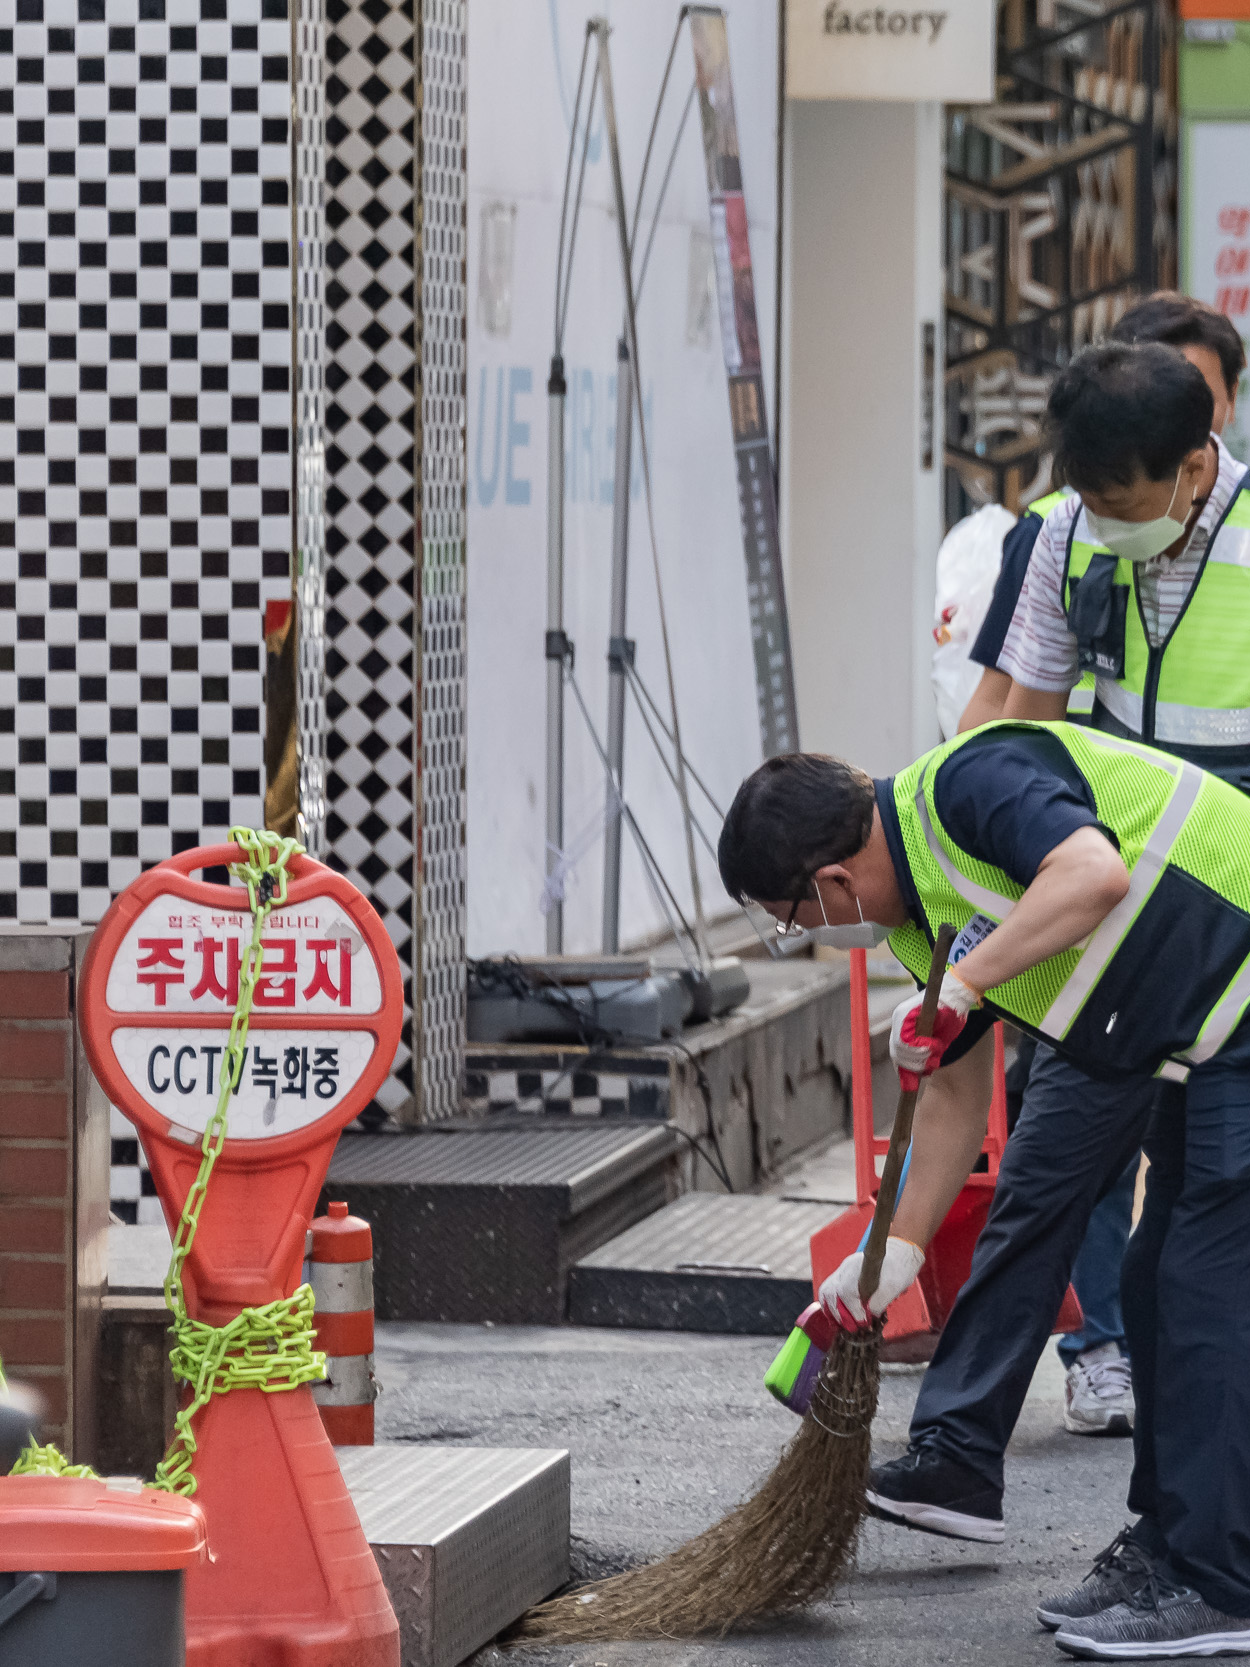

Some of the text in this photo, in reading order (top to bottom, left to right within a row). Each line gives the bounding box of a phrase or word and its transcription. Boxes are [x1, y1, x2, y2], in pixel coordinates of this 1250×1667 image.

[823, 0, 949, 47] factory
[168, 915, 202, 929] 협조
[211, 915, 244, 929] 부탁
[136, 937, 352, 1007] 주차금지
